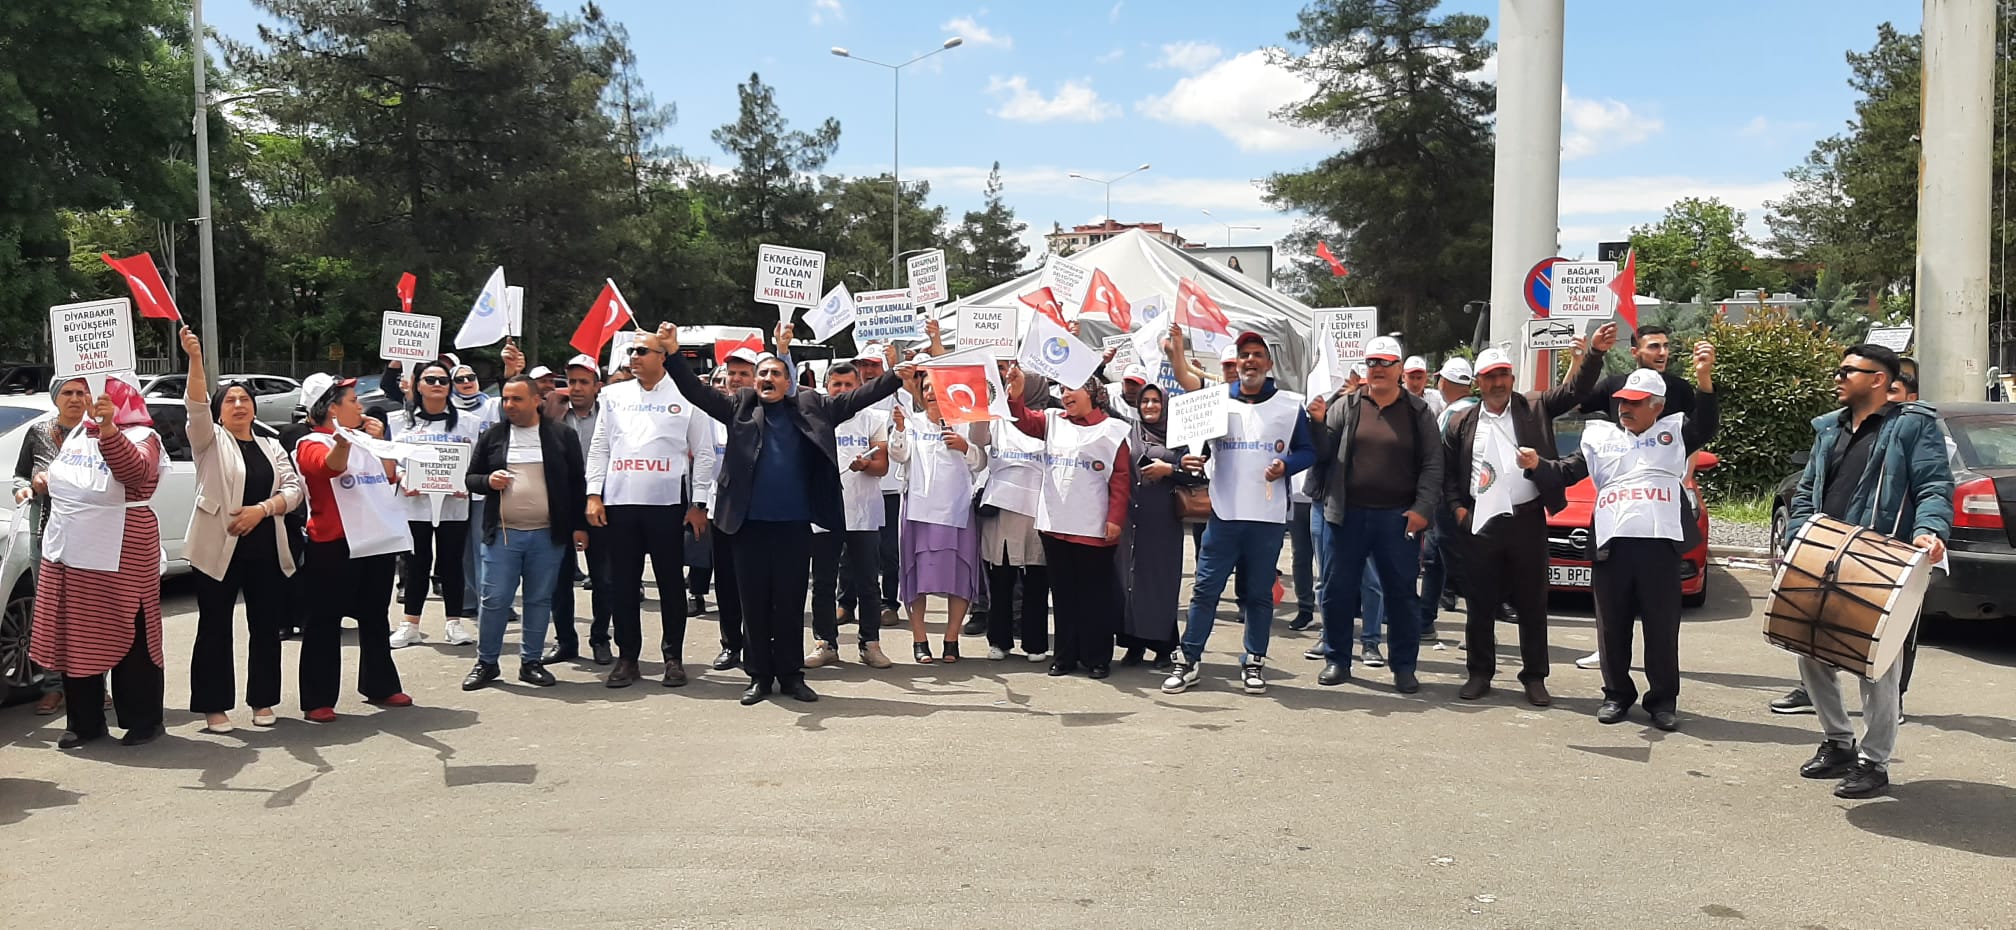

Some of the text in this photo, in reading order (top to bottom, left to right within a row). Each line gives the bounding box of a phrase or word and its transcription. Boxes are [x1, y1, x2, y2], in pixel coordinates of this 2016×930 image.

[763, 253, 819, 269] EKMEĞİME
[769, 265, 812, 279] UZANAN
[1567, 267, 1600, 276] BAĞLAR
[775, 277, 803, 289] ELLER
[1561, 275, 1605, 285] BELEDİYESİ
[764, 287, 805, 300] KIRILSIN
[1566, 285, 1598, 295] İŞÇİLERİ
[1562, 303, 1600, 312] DEĞİLDİR
[64, 308, 115, 322] DİYARBAKIR
[869, 314, 913, 326] SÜRGÜNLER
[973, 312, 1003, 320] ZULME
[1335, 312, 1353, 321] SUR
[63, 317, 118, 333] BÜYÜKŞEHİR
[387, 318, 436, 330] EKMEĞİME
[975, 322, 999, 330] KARŞI
[1320, 320, 1368, 330] BLEDİYESİ
[68, 328, 115, 343] BELEDİYESİ
[392, 328, 430, 339] UZANAN
[858, 328, 874, 338] SON
[76, 340, 109, 352] İŞÇİLERİ
[397, 338, 422, 348] ELLER
[959, 337, 1014, 347] DİRENECEĞİZ
[1335, 340, 1360, 349] ALNIZ
[79, 350, 108, 361] YALNIZ
[74, 360, 114, 372] DEĞİLDİR
[1221, 440, 1274, 454] hizmet-iş
[1599, 487, 1671, 509] GÖREVLİ
[1567, 568, 1591, 582] BPC
